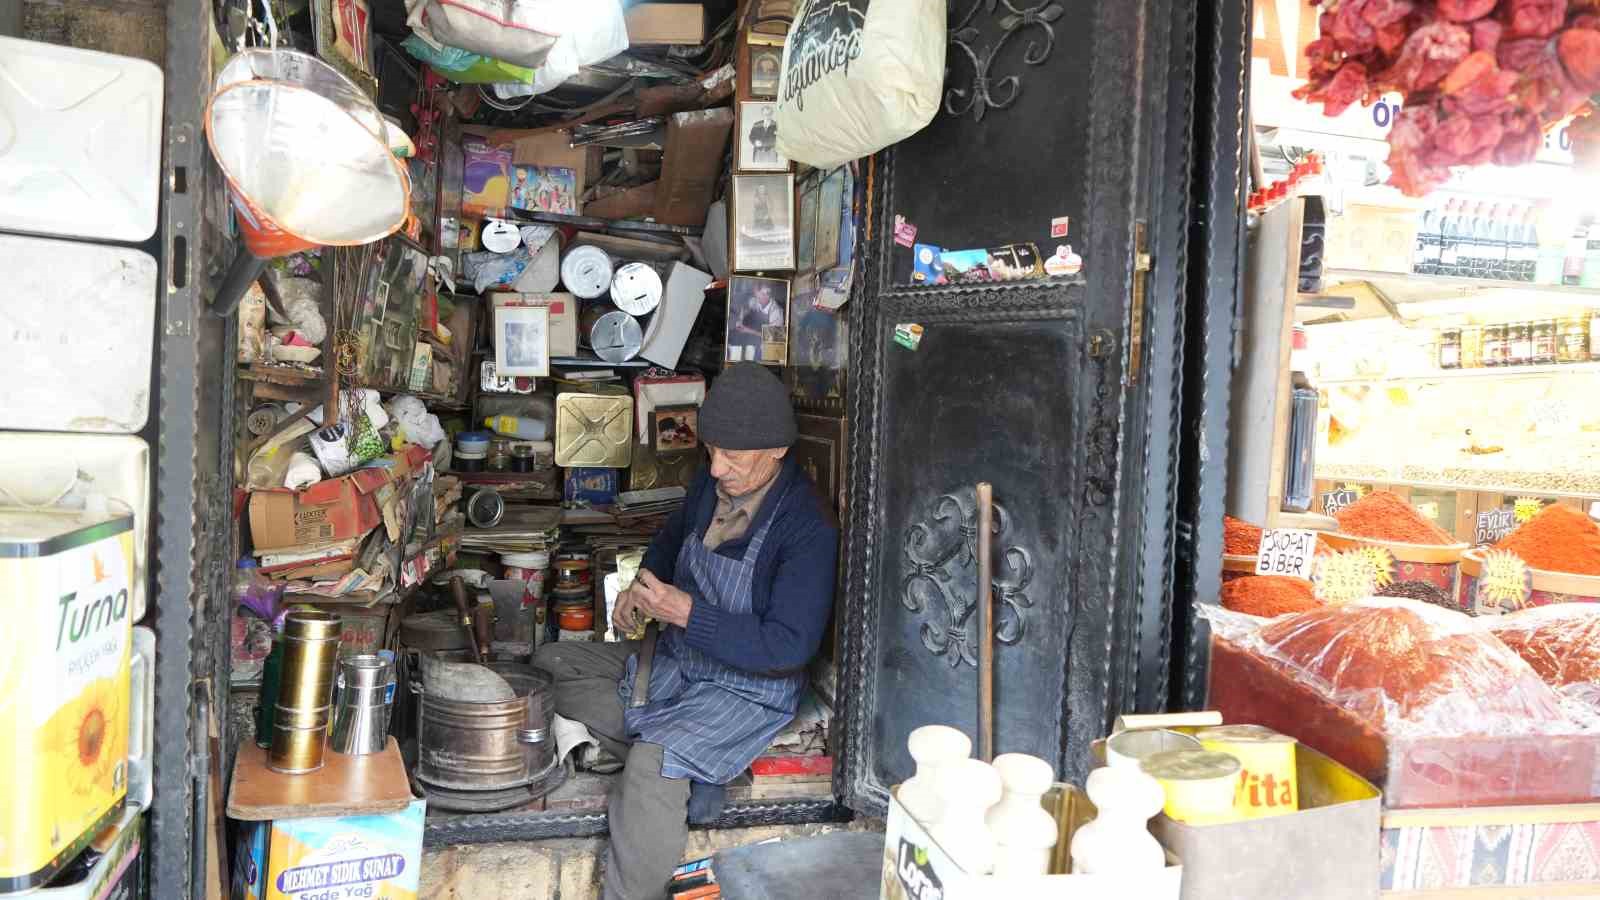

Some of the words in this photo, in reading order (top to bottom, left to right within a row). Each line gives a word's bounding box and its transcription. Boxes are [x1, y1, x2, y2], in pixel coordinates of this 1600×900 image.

[56, 588, 128, 652] Turna
[283, 866, 330, 891] MEHMET
[363, 855, 399, 879] SUNAY
[300, 886, 339, 900] Sade
[344, 882, 373, 898] Yağ
